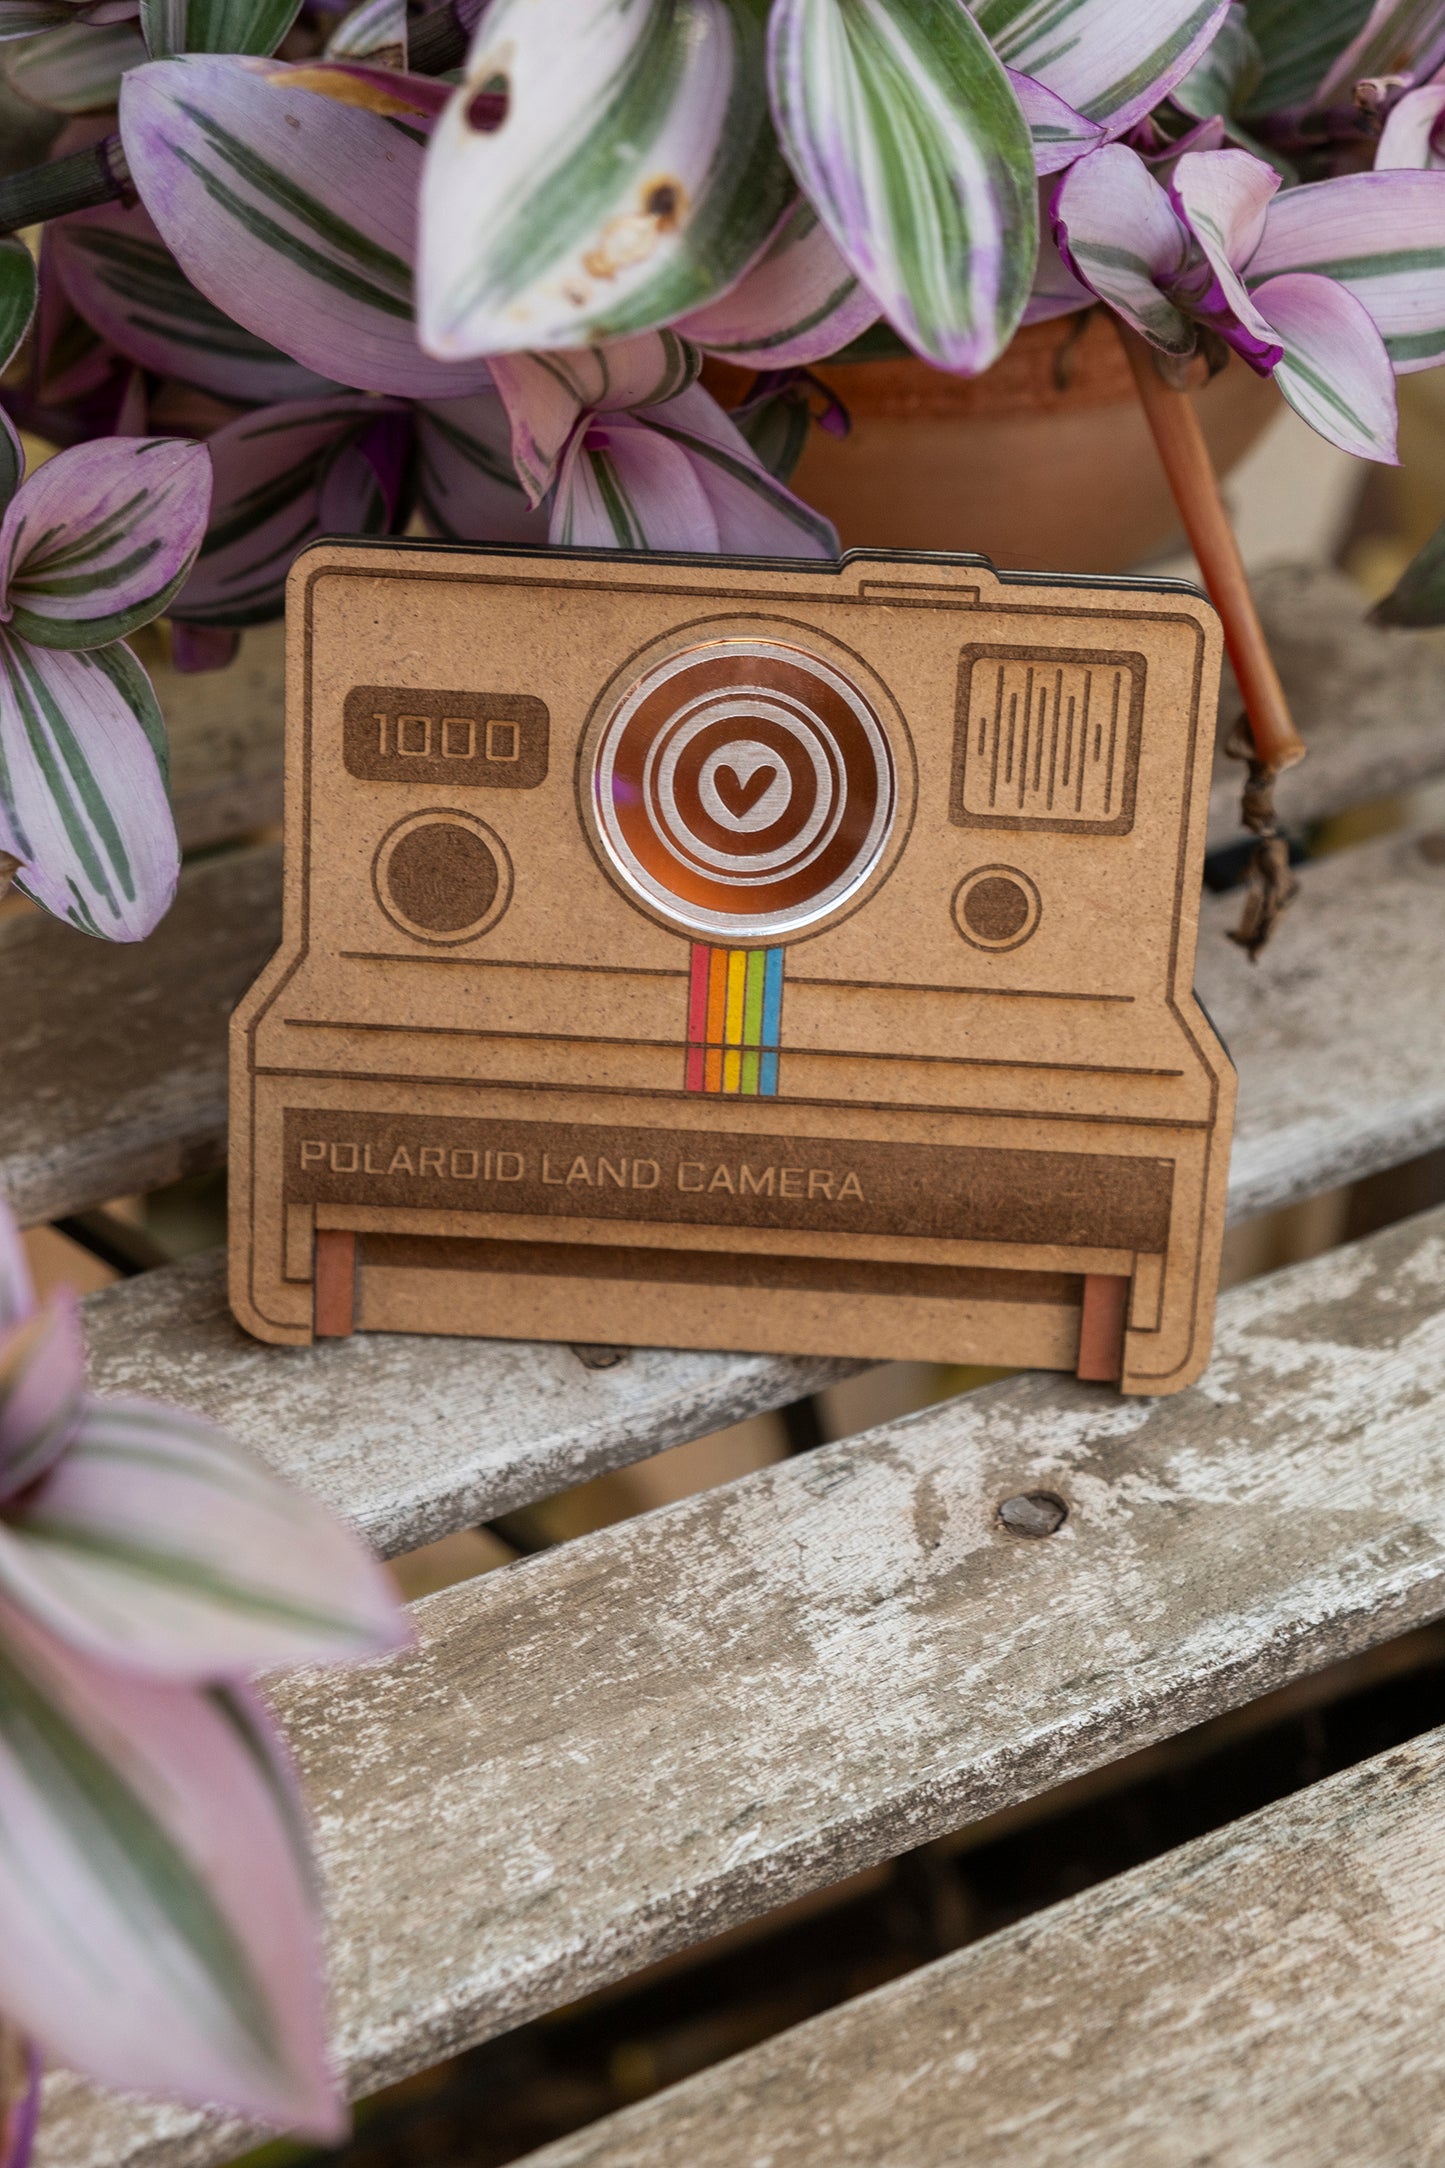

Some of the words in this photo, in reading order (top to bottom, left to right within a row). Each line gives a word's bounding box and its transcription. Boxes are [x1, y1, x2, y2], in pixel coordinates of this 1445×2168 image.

[372, 713, 520, 761] 1000
[300, 1140, 524, 1182] POLAROID
[543, 1153, 660, 1189] LAND
[677, 1161, 865, 1202] CAMERA
